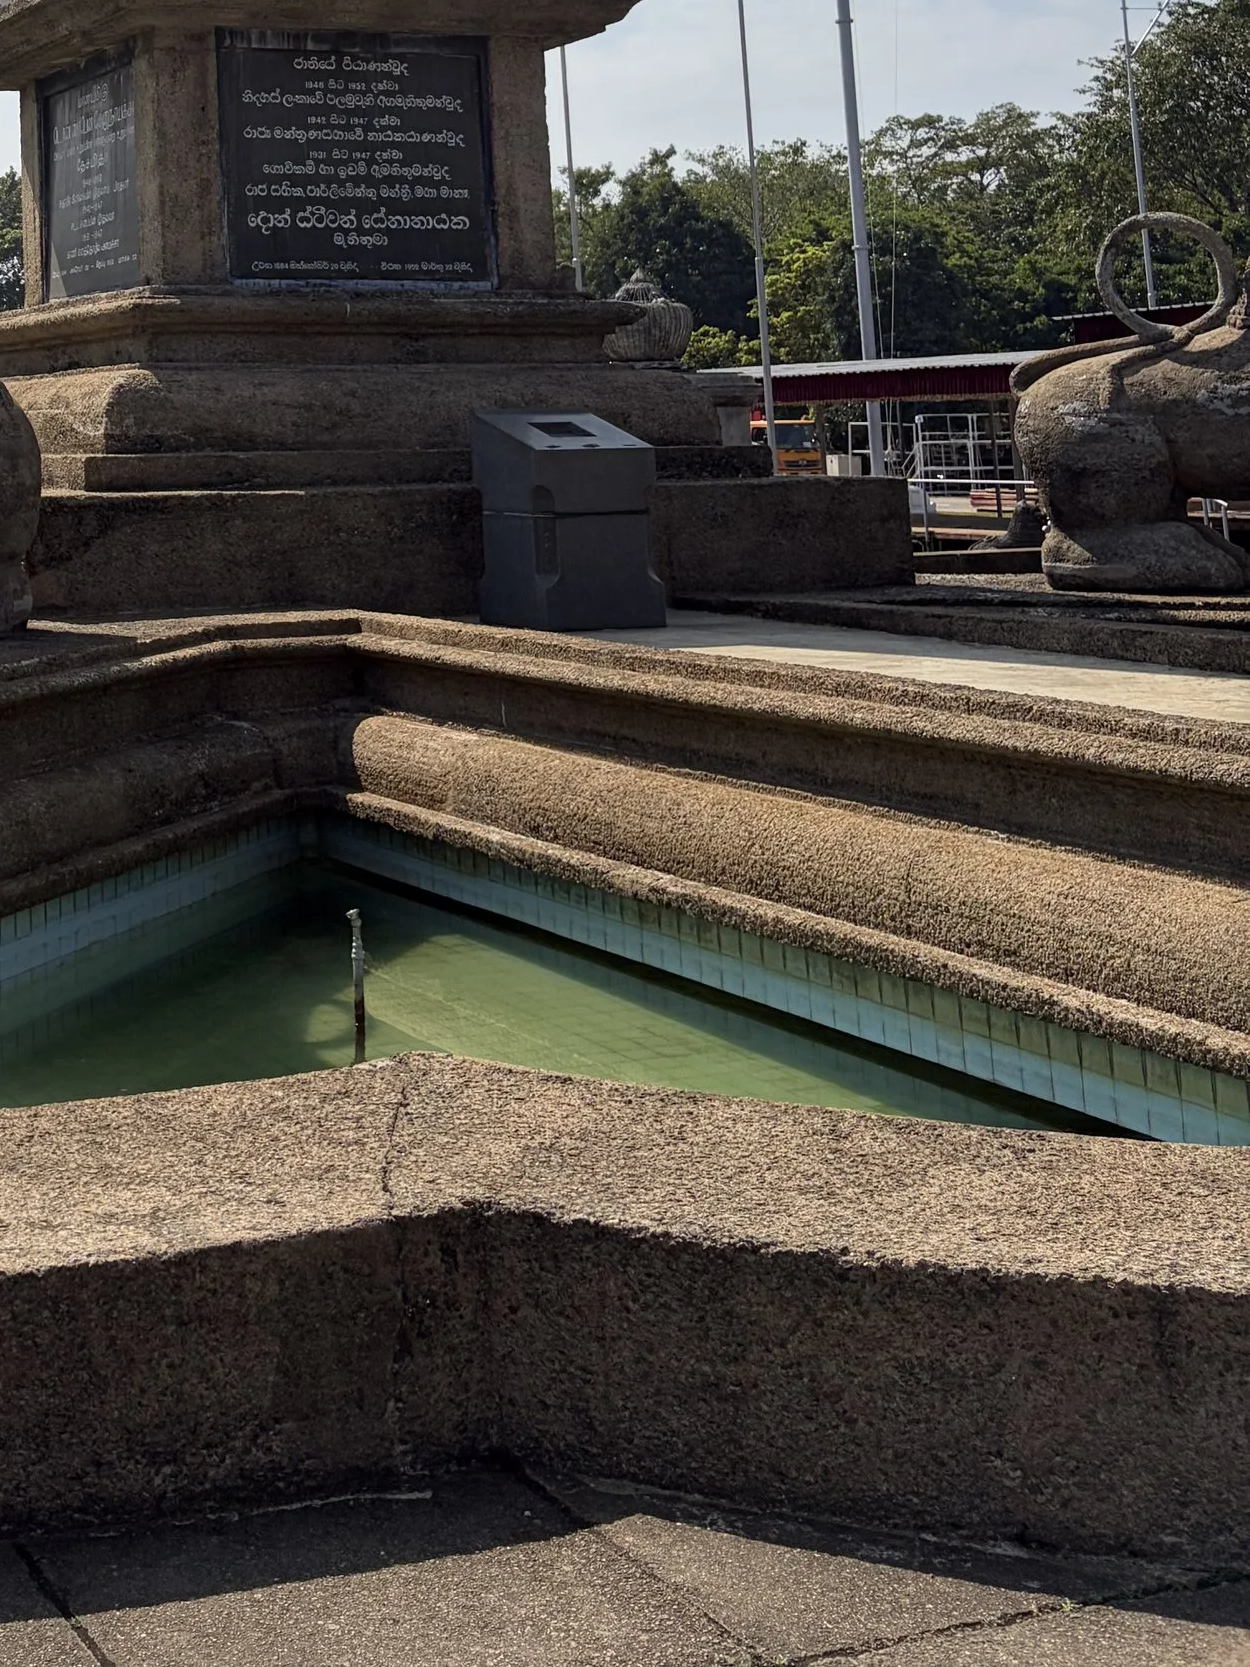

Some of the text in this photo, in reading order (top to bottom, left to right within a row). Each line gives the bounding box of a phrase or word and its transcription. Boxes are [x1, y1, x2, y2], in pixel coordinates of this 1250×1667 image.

[293, 56, 336, 71] ජාතියේ
[328, 79, 345, 90] සිට
[371, 80, 399, 93] දක්වා
[242, 88, 281, 107] නිදහස්
[282, 91, 325, 108] ලංකාවේ
[307, 114, 401, 129] 1942 සිට 1947 දක්වා
[309, 149, 403, 163] 1931 සිට 1947 දක්වා
[262, 159, 316, 175] ගොවිකම්
[319, 162, 335, 175] හා
[337, 161, 367, 178] ඉඩම්
[245, 183, 267, 197] රාජ
[414, 186, 437, 198] මහා
[247, 208, 291, 234] දොන්
[362, 207, 470, 230] සේනානායක
[333, 232, 388, 249] මැතිතුමා
